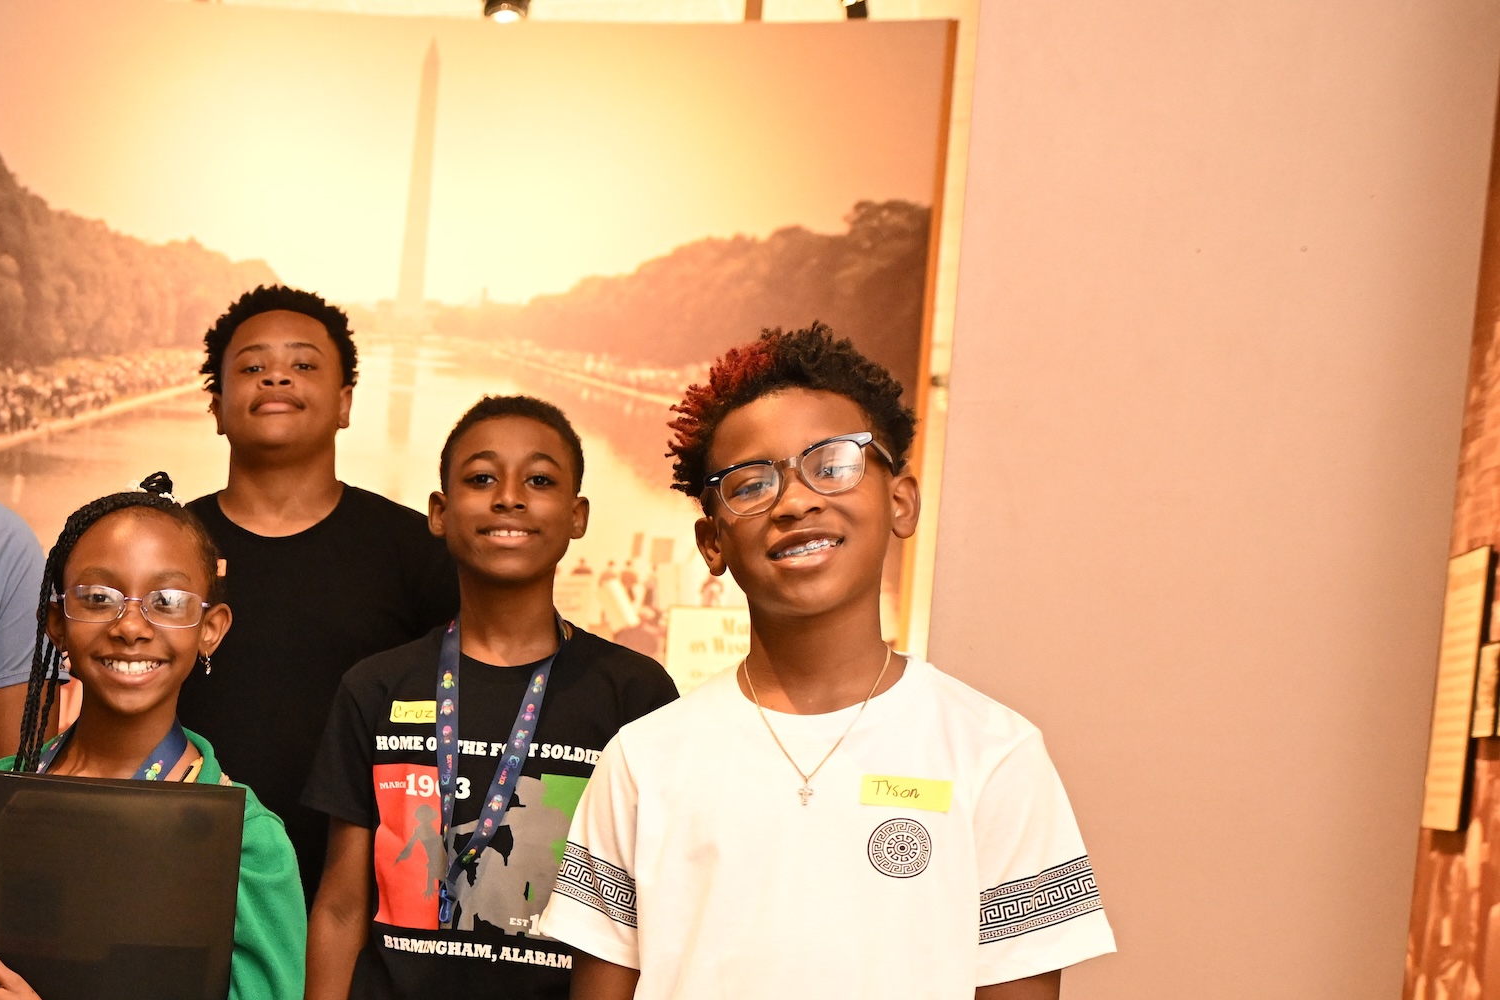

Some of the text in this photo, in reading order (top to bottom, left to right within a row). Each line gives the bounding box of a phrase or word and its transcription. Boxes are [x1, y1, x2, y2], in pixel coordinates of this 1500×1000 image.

[393, 705, 436, 719] Cruz
[375, 735, 424, 751] HOME
[490, 741, 540, 758] FT
[405, 773, 471, 800] 193
[509, 917, 529, 928] EST
[383, 934, 498, 962] BIRMINGHAM,
